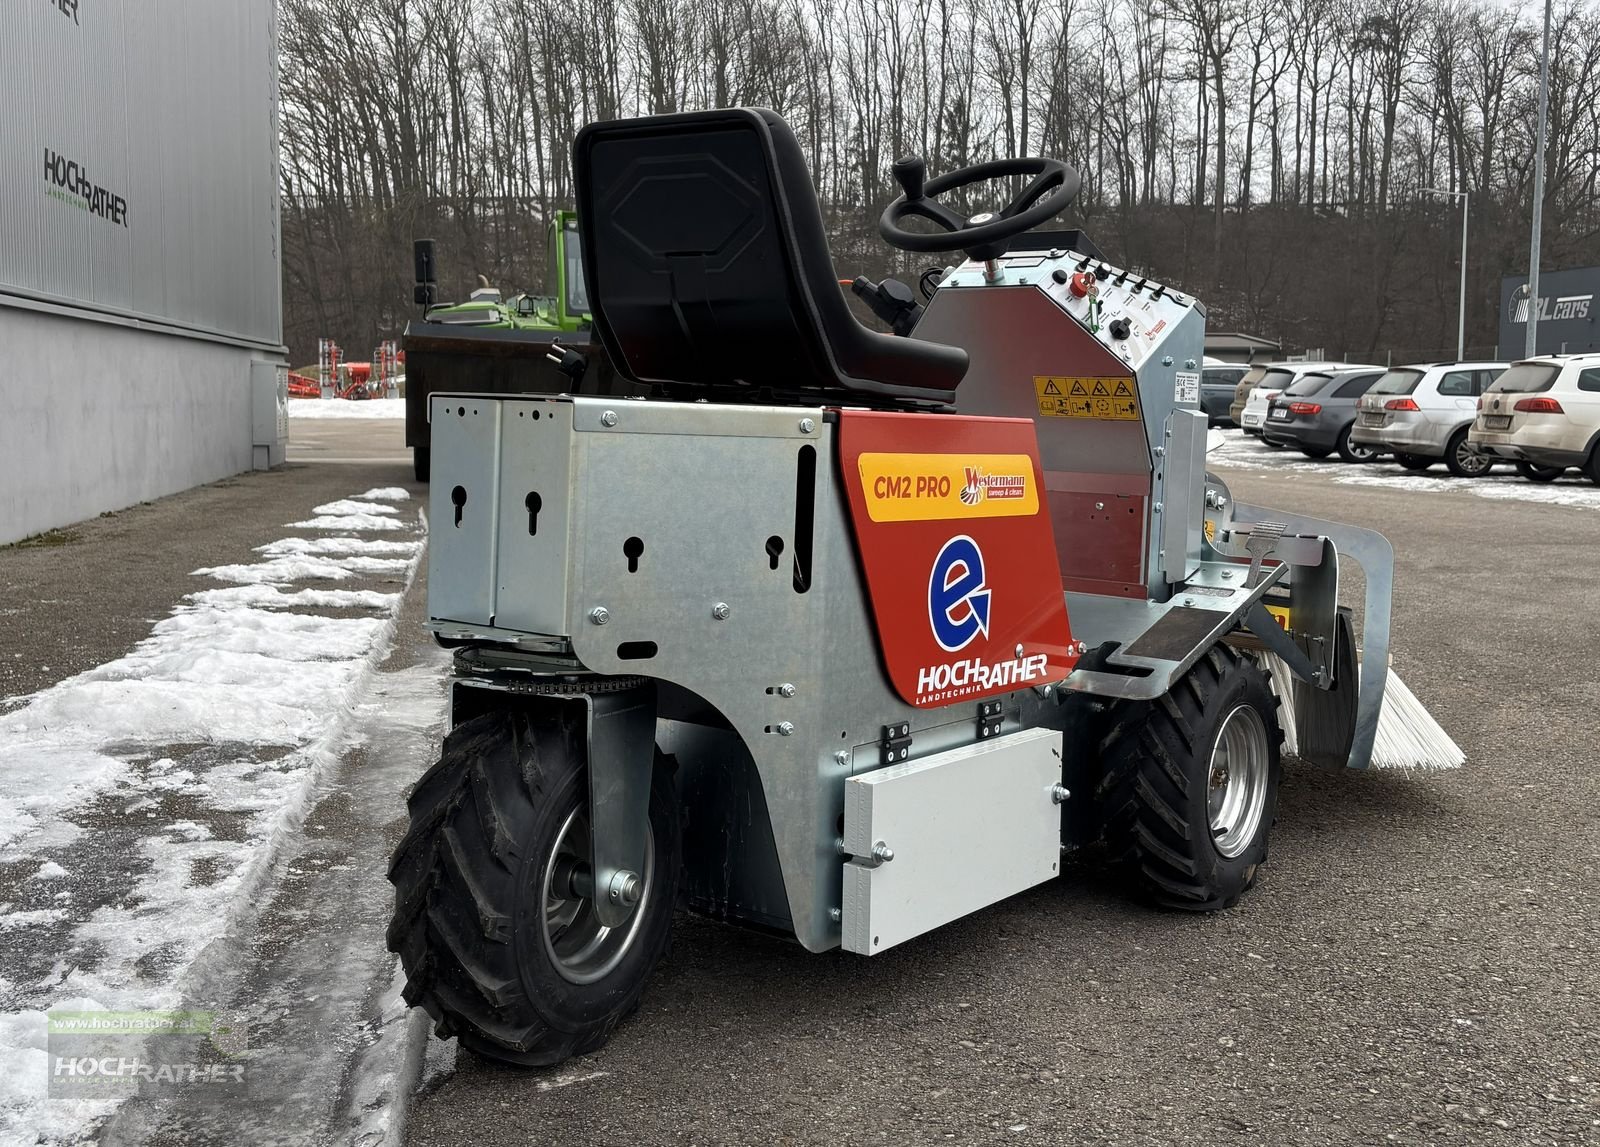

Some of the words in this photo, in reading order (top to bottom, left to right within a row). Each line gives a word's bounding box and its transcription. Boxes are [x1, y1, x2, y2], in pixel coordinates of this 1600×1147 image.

[44, 147, 128, 228] HOCHRATHER
[1552, 300, 1590, 320] cars
[873, 475, 912, 499] CM2
[915, 475, 951, 498] PRO
[965, 467, 1025, 491] Westermann
[1004, 488, 1009, 496] &
[917, 653, 1048, 694] HOCHRATHER
[915, 684, 982, 705] LANDTECHNIK
